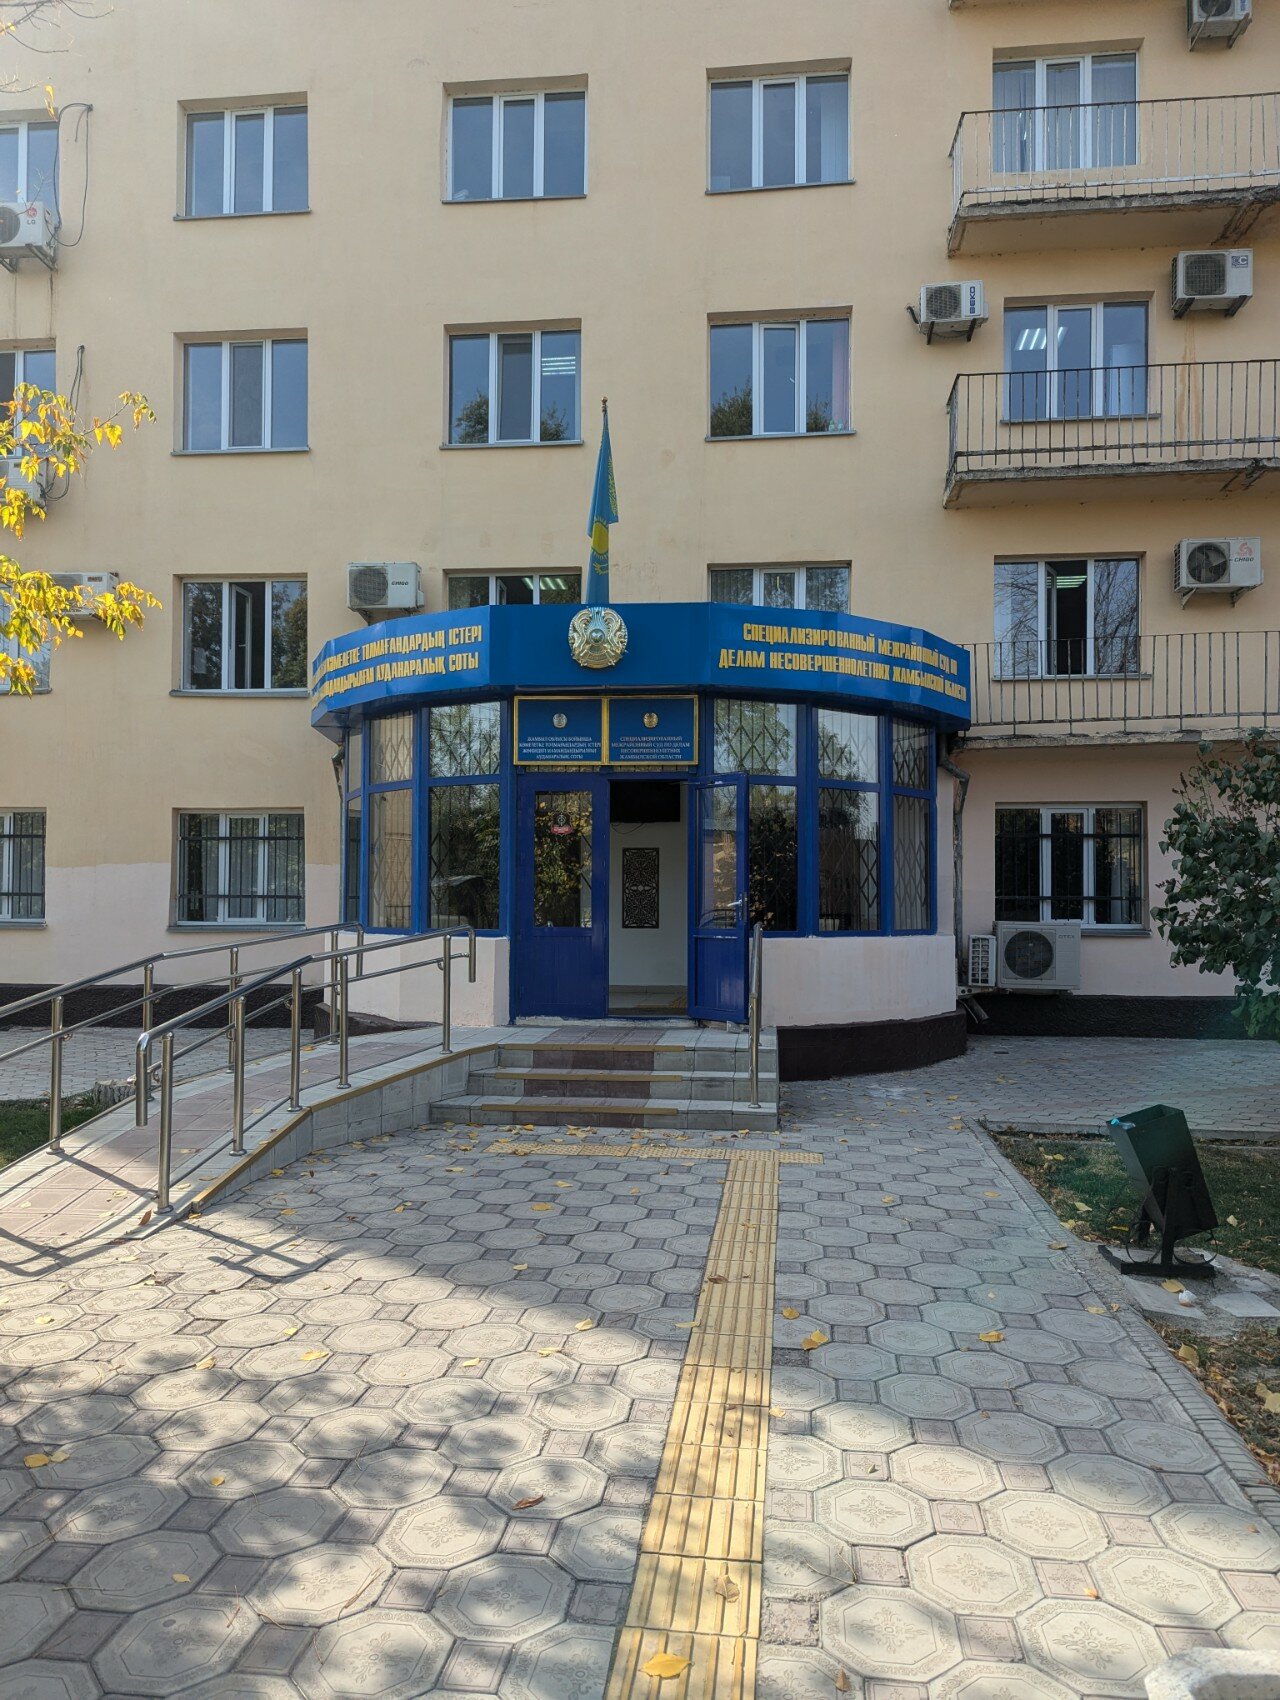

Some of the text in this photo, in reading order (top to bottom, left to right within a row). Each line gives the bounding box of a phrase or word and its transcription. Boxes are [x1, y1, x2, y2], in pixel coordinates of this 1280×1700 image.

[448, 625, 483, 646] ІСТЕРІ
[743, 622, 876, 654] СПЕЦИАЛИЗИРОВАННЫЙ
[376, 655, 446, 682] АУДАНАРАЛЫҚ
[448, 652, 480, 673] СОТЫ
[718, 648, 766, 669] ДЕЛАМ
[769, 651, 890, 681] НЕСОВЕРШЕННОЛЕТНИХ
